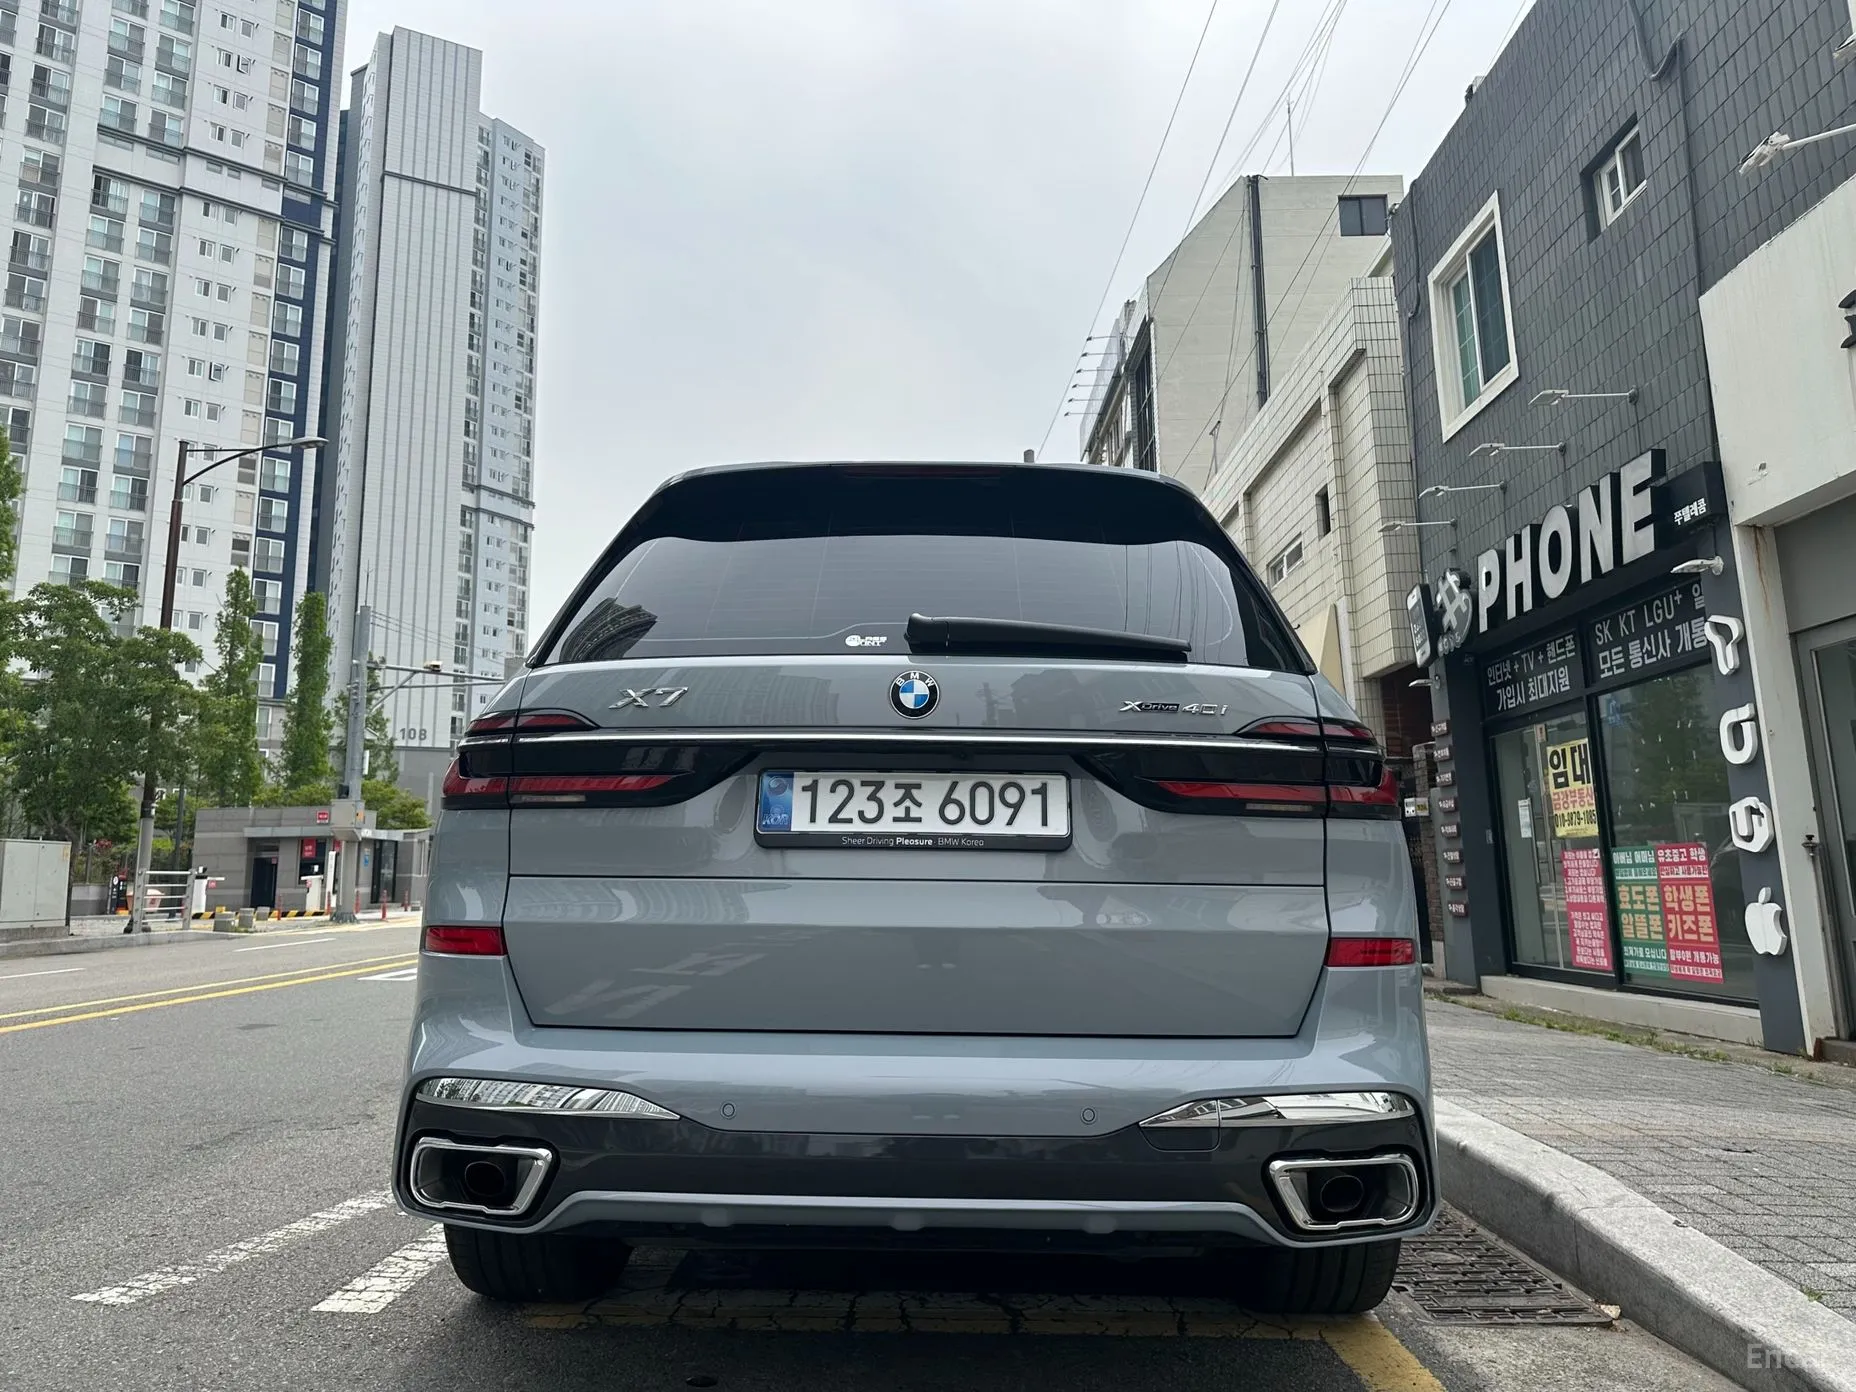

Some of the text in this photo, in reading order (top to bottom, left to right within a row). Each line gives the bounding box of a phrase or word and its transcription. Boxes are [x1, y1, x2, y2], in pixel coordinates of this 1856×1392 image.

[1477, 449, 1655, 634] PHONE
[1595, 619, 1613, 646] SK
[1618, 609, 1636, 637] KT
[1643, 589, 1683, 627] LGU+
[1598, 616, 1708, 679] 모든 통신사 개통
[895, 671, 935, 687] BMW
[1487, 660, 1512, 686] 인터넷
[1521, 650, 1534, 673] TV
[608, 686, 689, 709] X7
[1496, 665, 1571, 711] 가입시 최대지원
[1549, 743, 1592, 789] 임대
[801, 779, 1048, 827] 123조 6091
[1552, 785, 1595, 811] 금강부동산
[762, 812, 790, 825] KOR
[842, 836, 985, 847] Sheer Driving Pleasure BMW Korea
[1657, 847, 1706, 863] 유초중고 학생
[1617, 885, 1660, 911] 효도폰
[1663, 885, 1711, 912] 학생폰
[1621, 913, 1664, 940] 알뜰폰
[1666, 914, 1715, 942] 키즈폰
